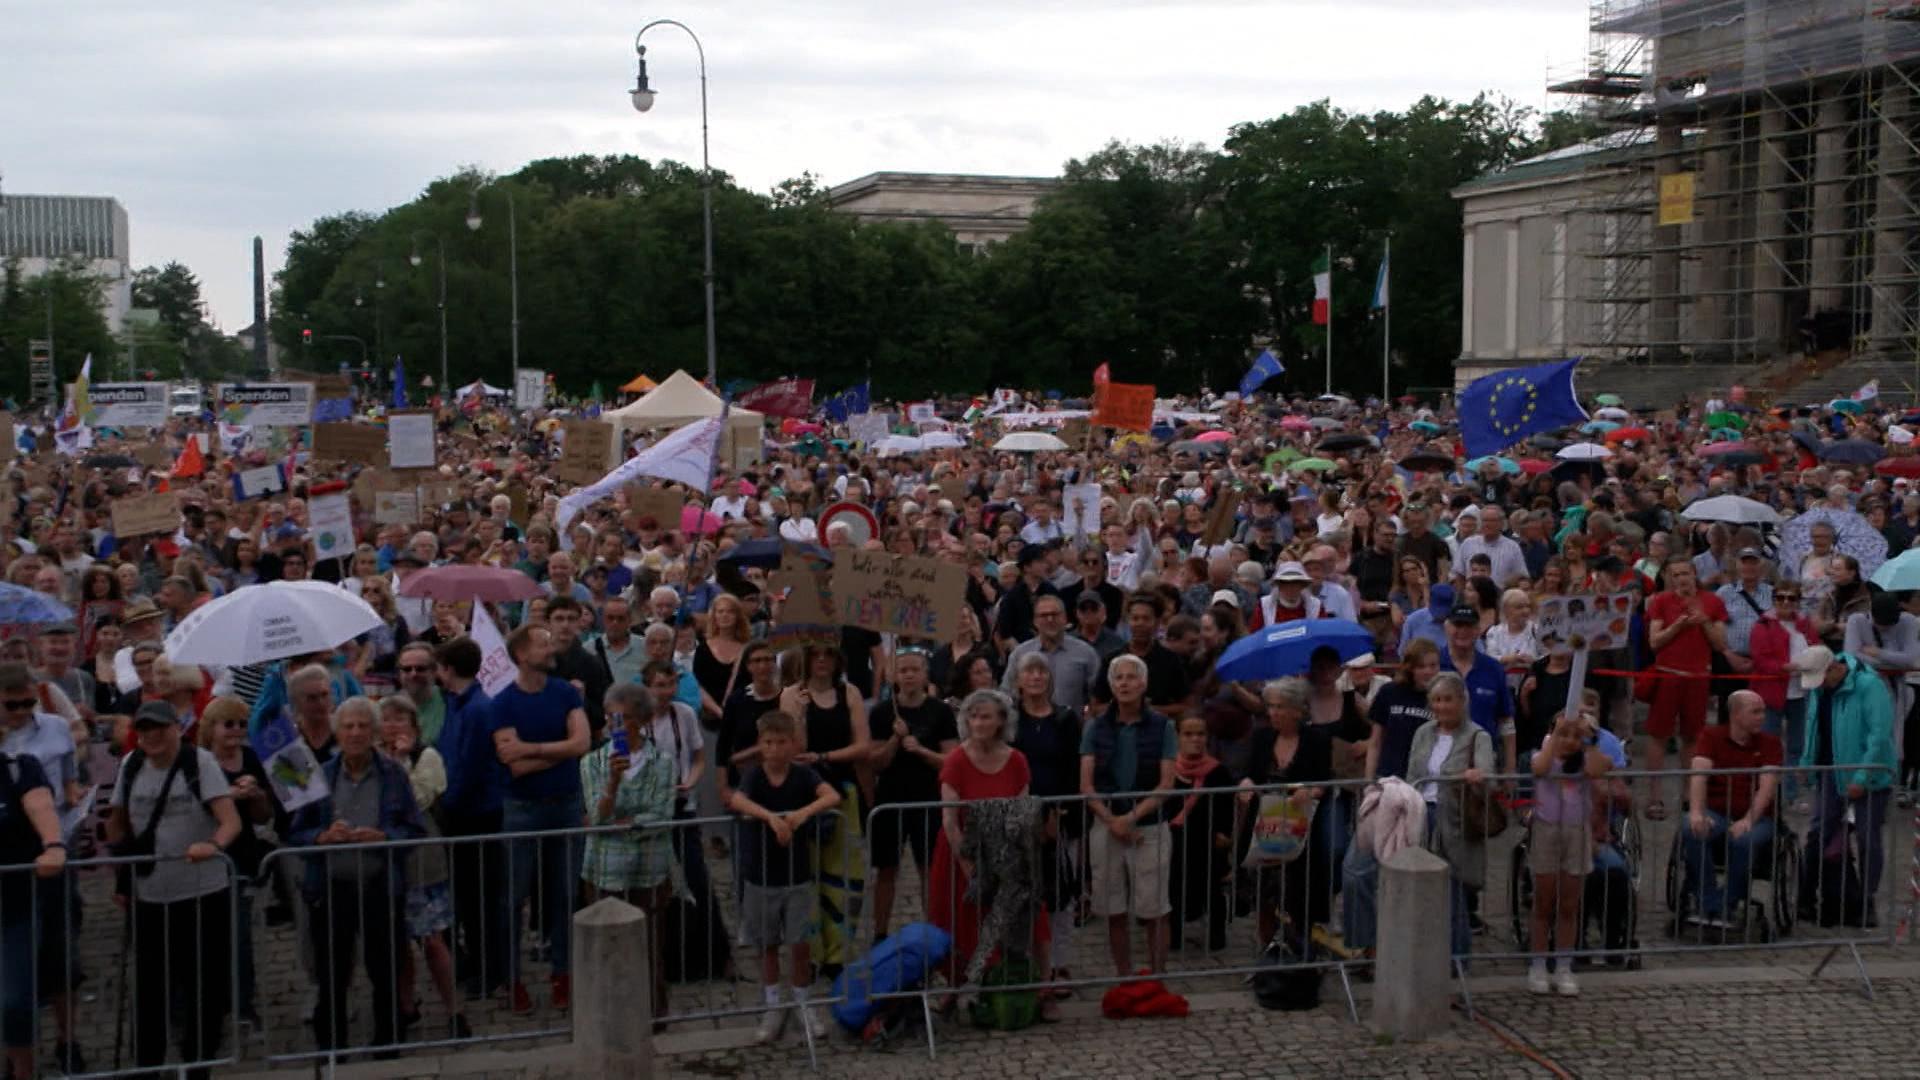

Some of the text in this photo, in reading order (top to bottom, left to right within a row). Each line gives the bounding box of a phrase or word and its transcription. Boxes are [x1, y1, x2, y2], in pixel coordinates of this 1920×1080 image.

[88, 388, 144, 403] penden
[223, 388, 289, 403] Spenden
[852, 554, 879, 575] Wir
